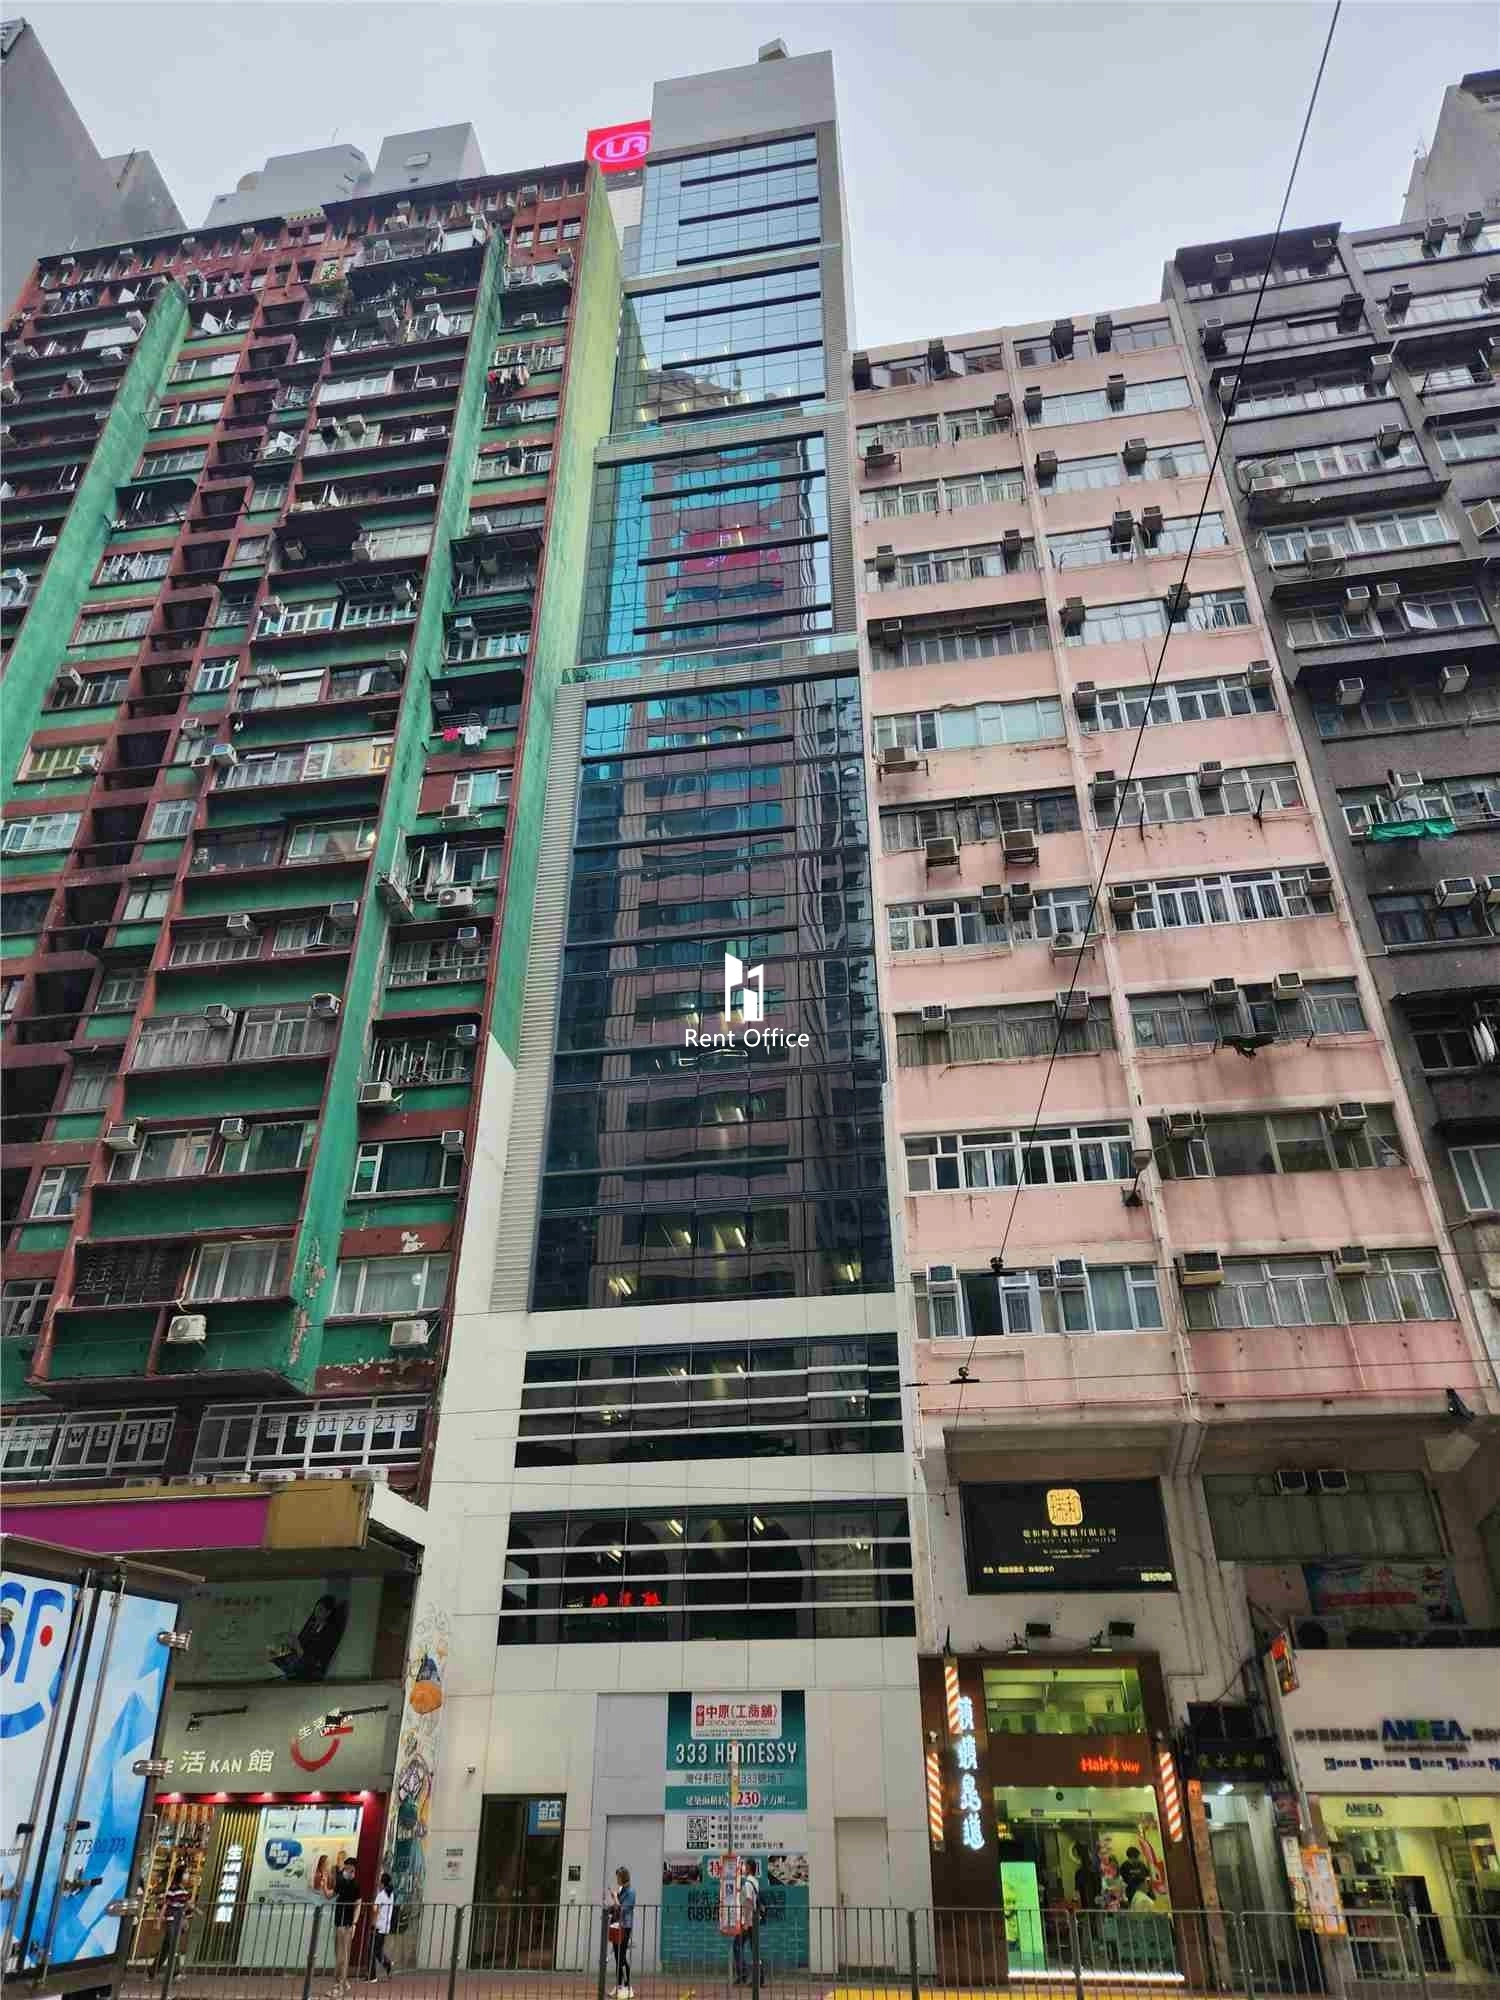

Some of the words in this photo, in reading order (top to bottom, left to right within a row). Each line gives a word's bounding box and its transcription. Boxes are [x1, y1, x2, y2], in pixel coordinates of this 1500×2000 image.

[180, 1750, 207, 1773] 活
[209, 1759, 242, 1773] KAN
[247, 1748, 275, 1773] 館
[675, 1743, 708, 1764] 333
